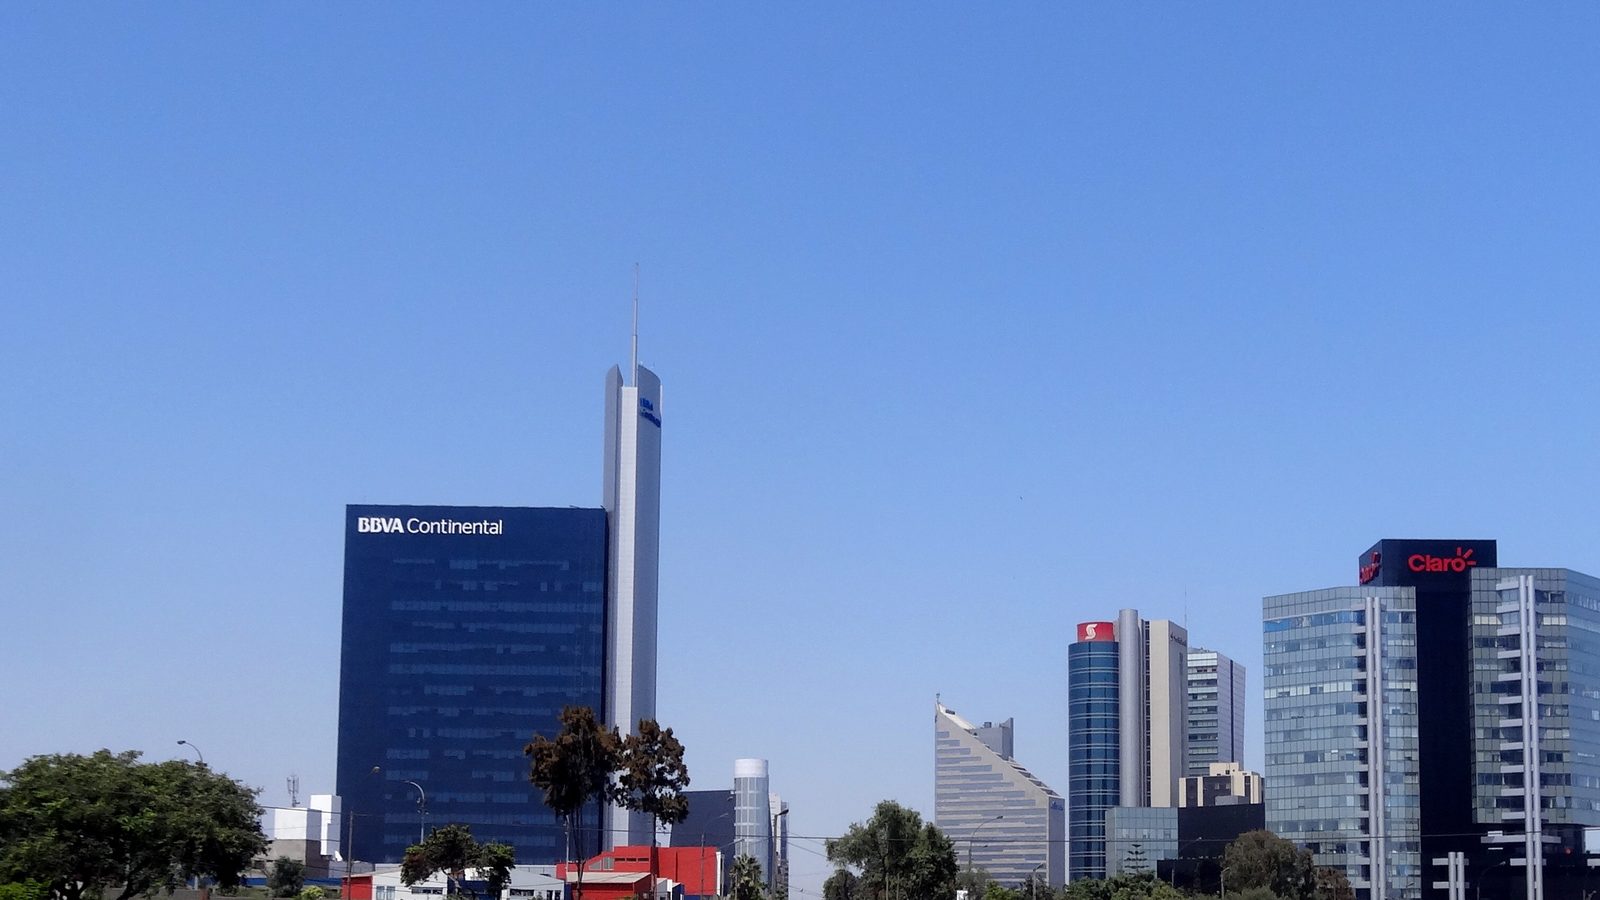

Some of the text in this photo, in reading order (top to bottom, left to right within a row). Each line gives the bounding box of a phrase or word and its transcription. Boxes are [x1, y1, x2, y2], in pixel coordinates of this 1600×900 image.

[358, 517, 503, 535] BBVA Continental
[1408, 554, 1466, 572] Claro
